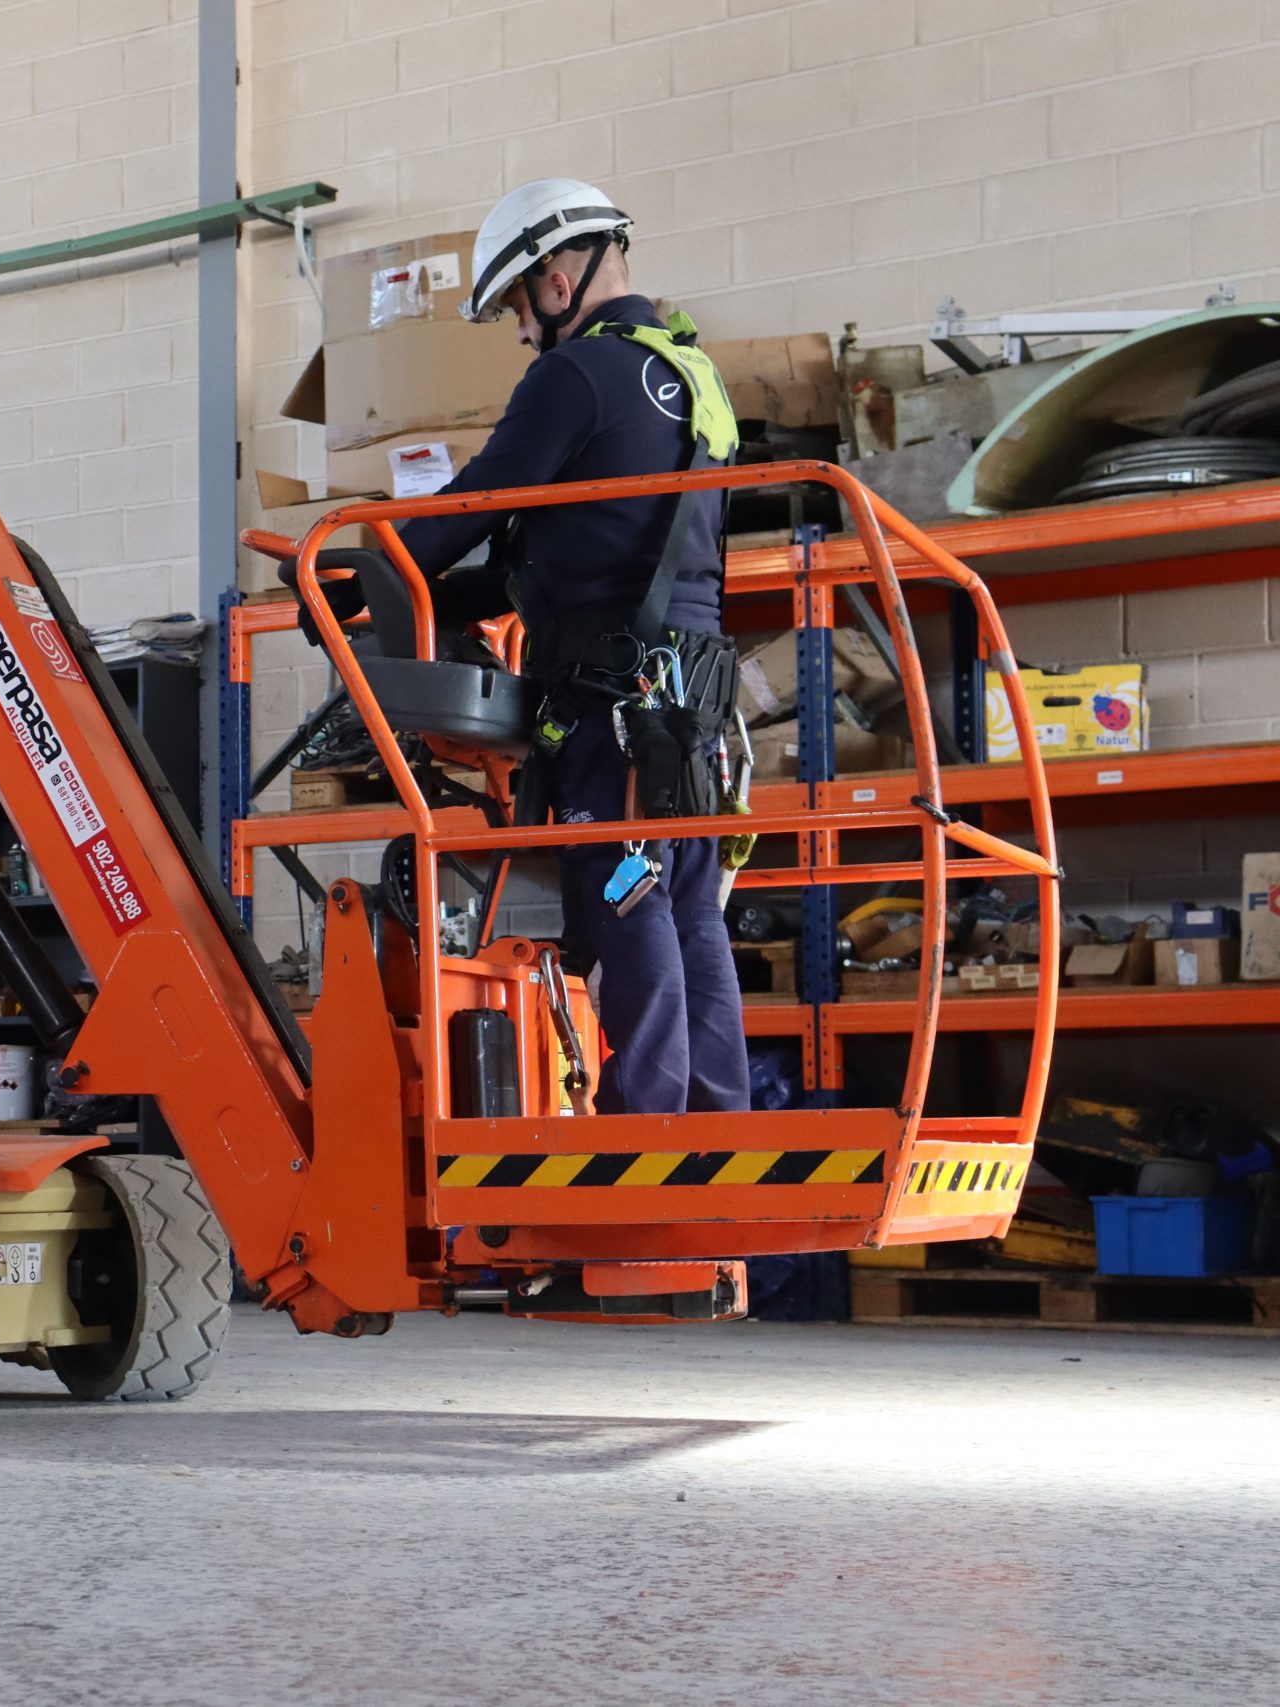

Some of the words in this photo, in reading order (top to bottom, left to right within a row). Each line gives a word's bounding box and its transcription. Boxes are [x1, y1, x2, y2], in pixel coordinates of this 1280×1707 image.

[6, 706, 45, 770] ALQUILER
[1096, 735, 1131, 745] Natur
[57, 786, 69, 801] 687
[65, 801, 78, 817] 880
[73, 816, 86, 832] 162
[92, 839, 115, 869] 902
[105, 865, 128, 894] 240
[119, 891, 142, 920] 988
